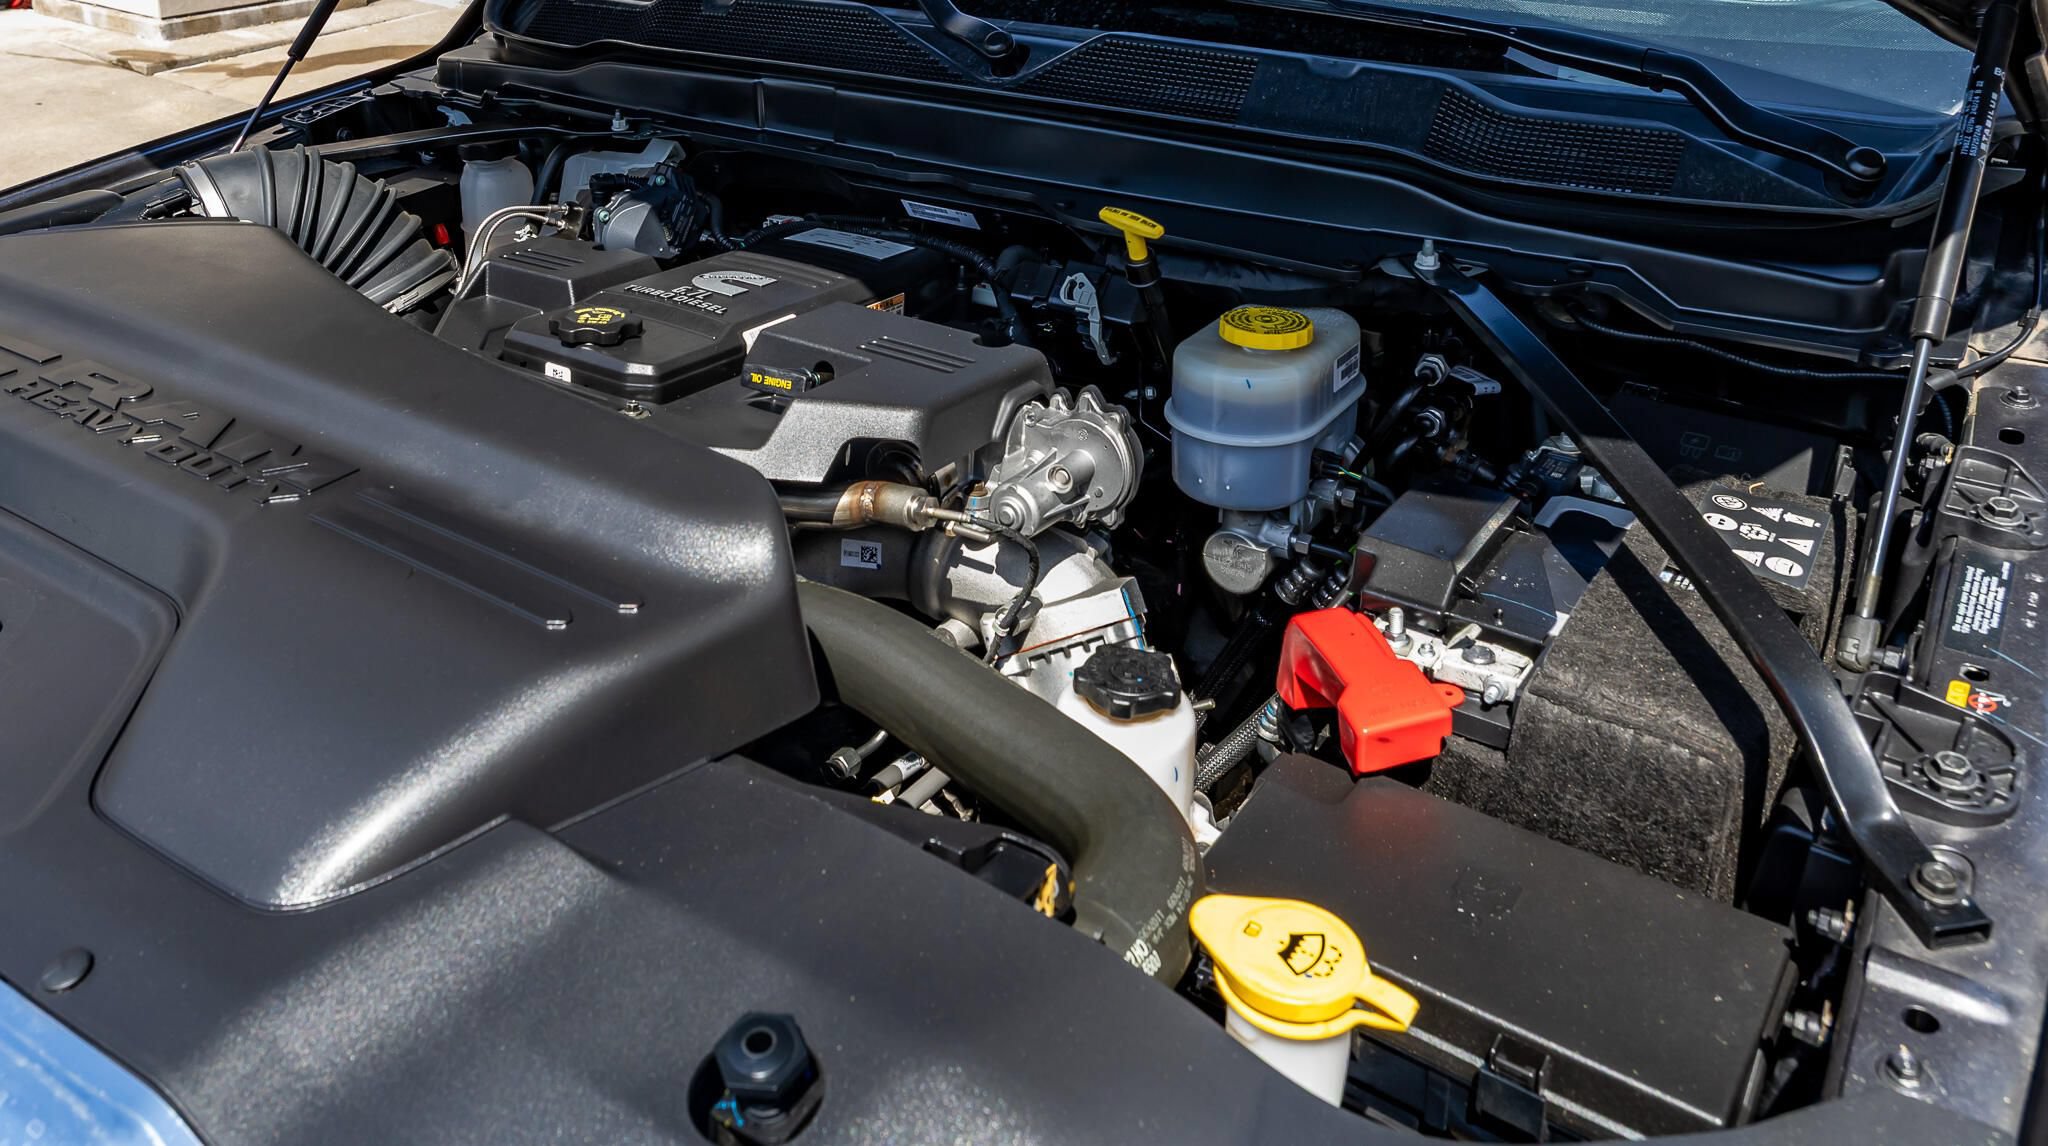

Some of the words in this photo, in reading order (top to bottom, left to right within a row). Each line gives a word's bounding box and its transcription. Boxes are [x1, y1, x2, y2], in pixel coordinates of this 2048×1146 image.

[1980, 91, 1998, 152] STABILUS
[623, 284, 676, 299] TURBO
[672, 293, 728, 315] DIESEL
[672, 285, 714, 299] 6.7L
[750, 372, 763, 384] OIL
[763, 375, 792, 390] ENGINE
[3, 379, 163, 446] HEAVY
[145, 440, 302, 506] DUTY
[38, 359, 361, 495] RAM
